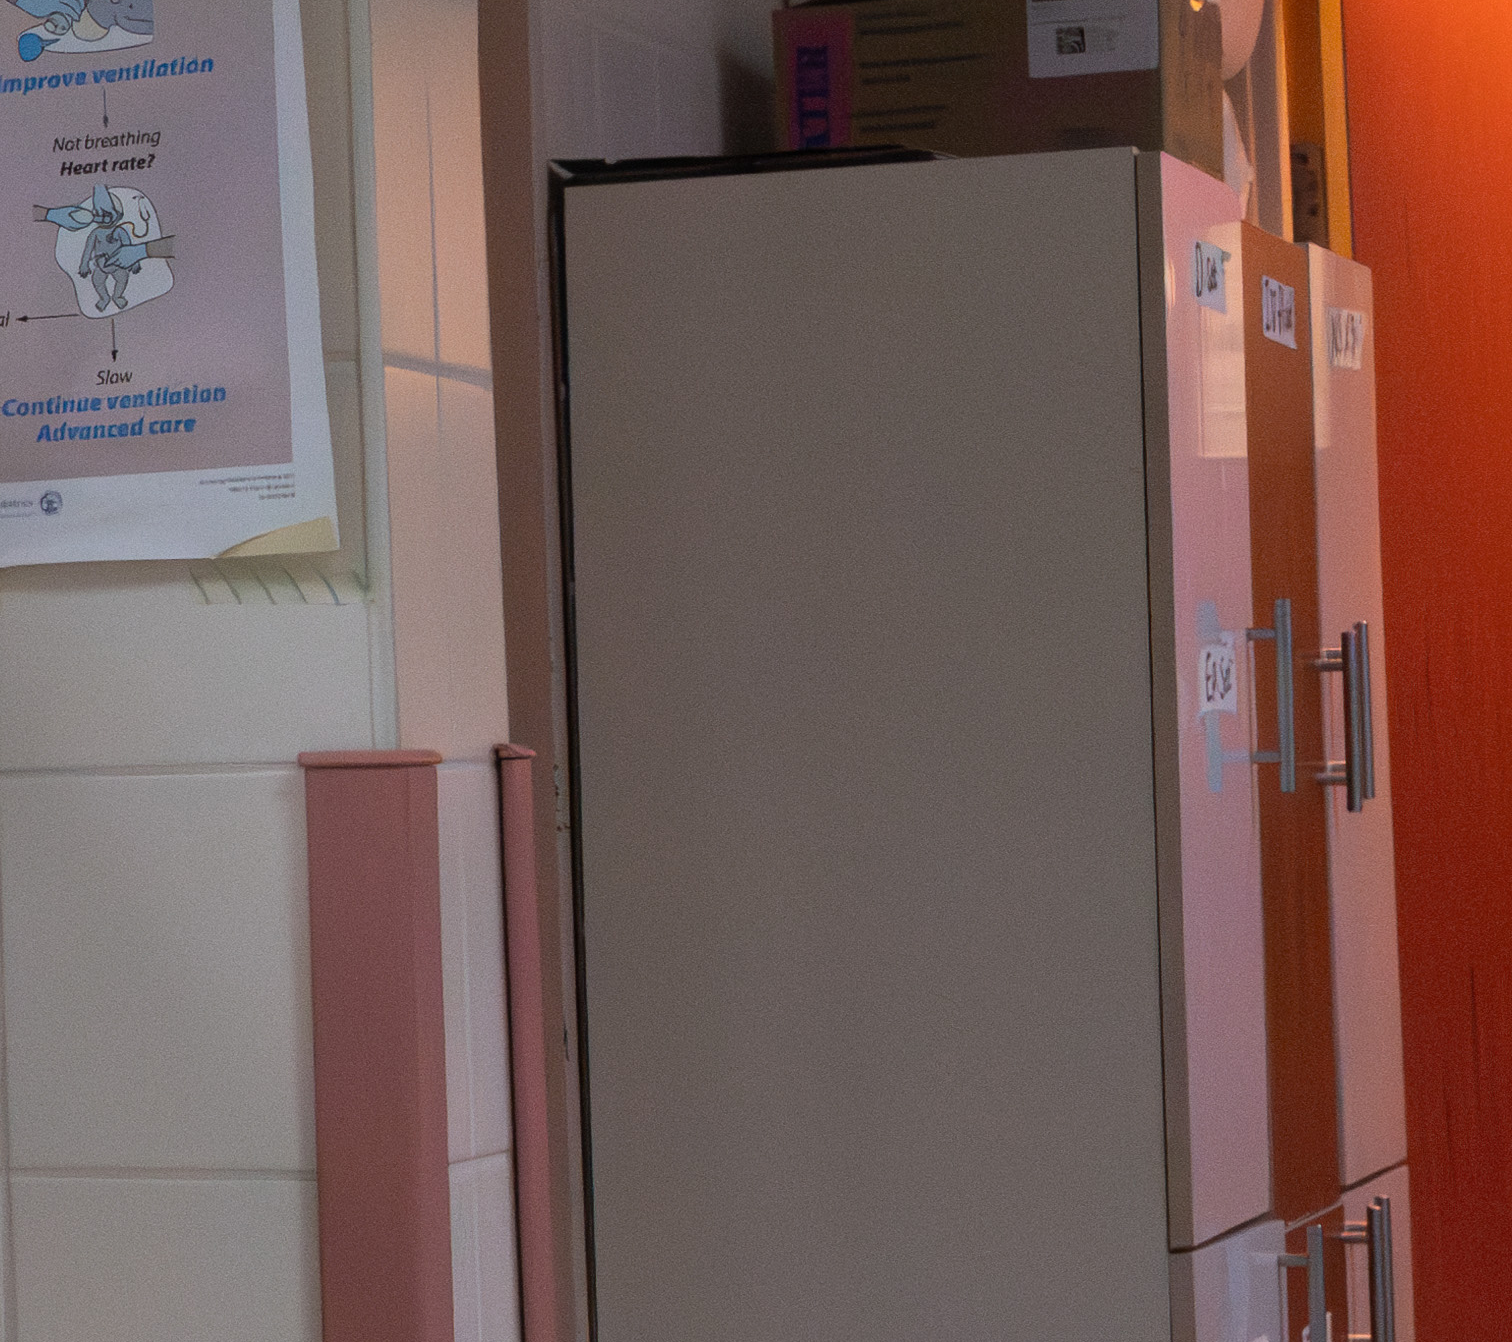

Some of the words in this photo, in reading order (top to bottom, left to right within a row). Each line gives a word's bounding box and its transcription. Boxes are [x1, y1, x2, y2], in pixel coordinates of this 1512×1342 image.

[92, 55, 215, 85] ventilation
[52, 136, 82, 153] Not
[84, 129, 162, 151] breathing
[60, 158, 109, 177] Heart
[111, 153, 156, 172] rate?
[95, 370, 134, 386] Slow
[0, 395, 103, 417] Continue
[107, 384, 228, 410] ventilation
[36, 417, 145, 443] Advanced
[147, 416, 197, 436] care
